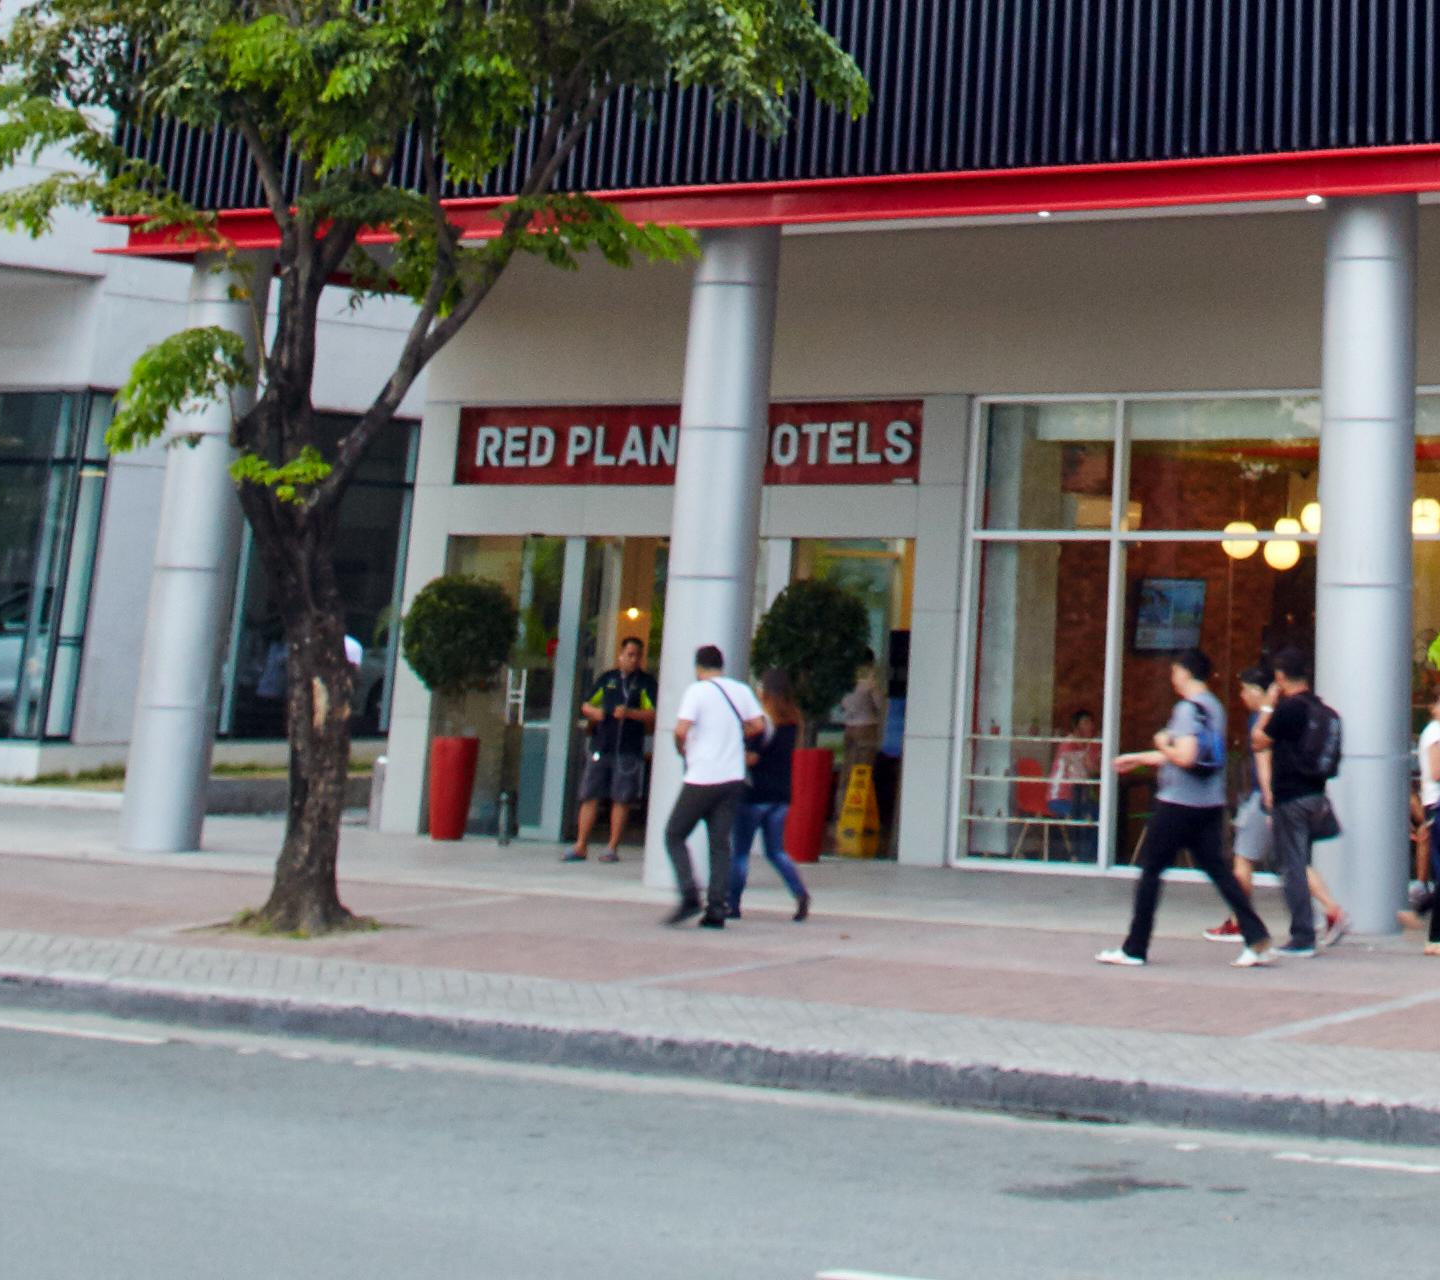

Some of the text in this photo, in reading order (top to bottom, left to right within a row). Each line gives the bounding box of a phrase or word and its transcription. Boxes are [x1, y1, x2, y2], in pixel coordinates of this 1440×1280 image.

[475, 420, 914, 468] RED PLAN OTELS
